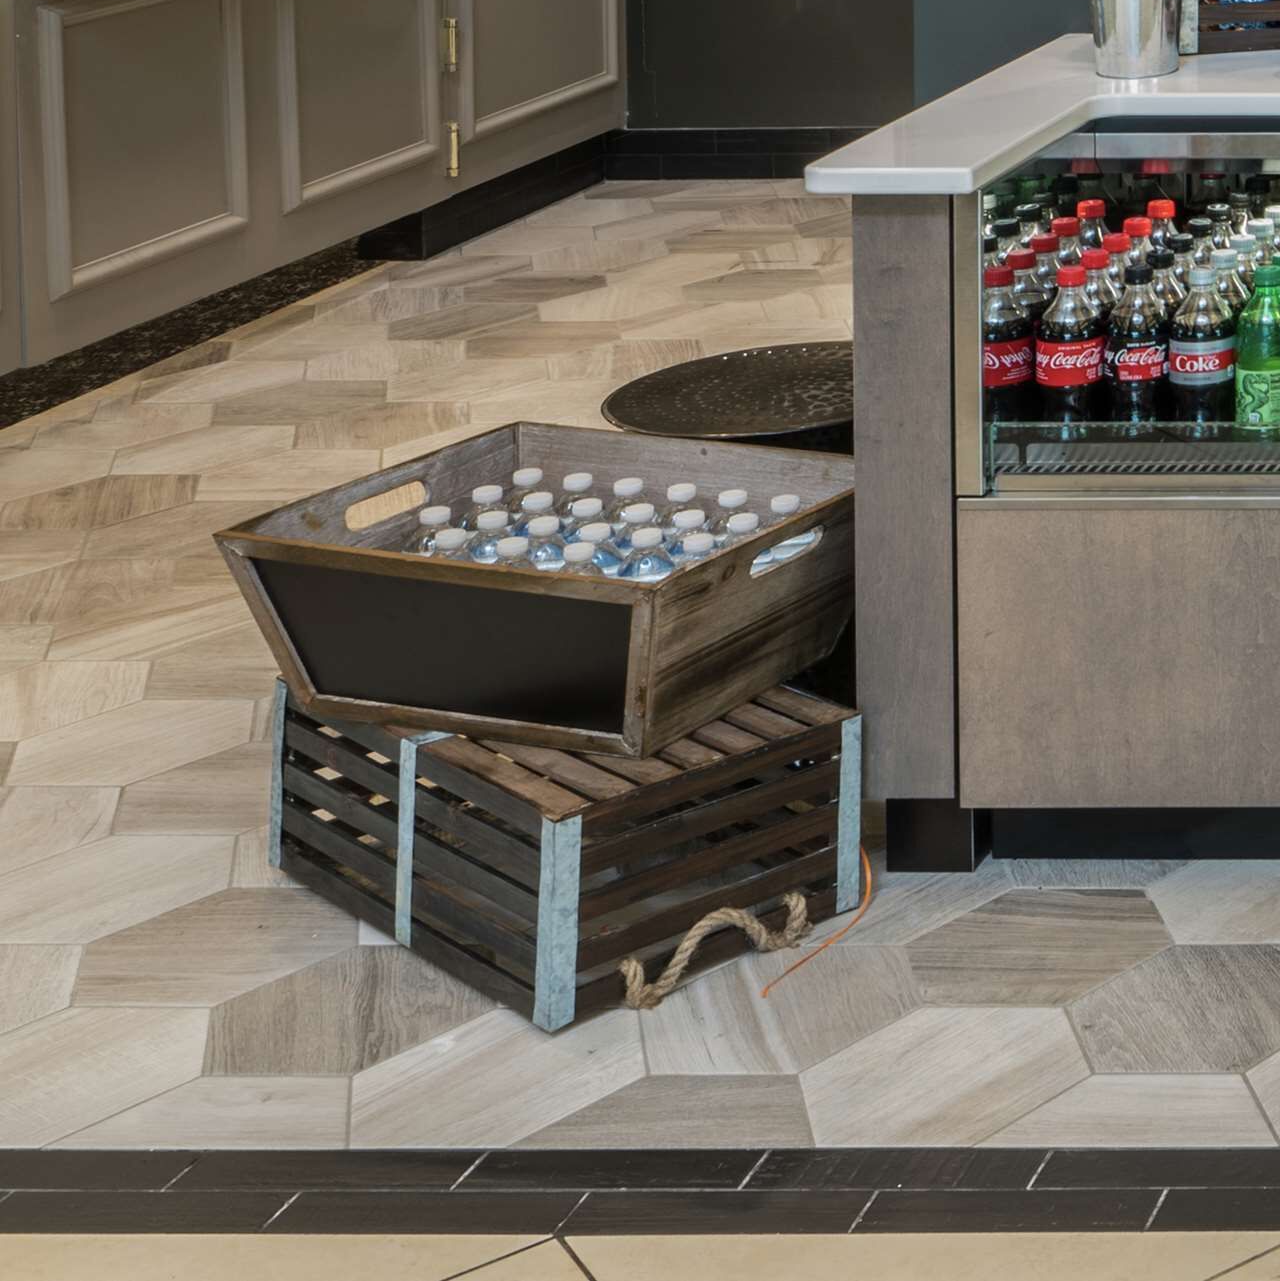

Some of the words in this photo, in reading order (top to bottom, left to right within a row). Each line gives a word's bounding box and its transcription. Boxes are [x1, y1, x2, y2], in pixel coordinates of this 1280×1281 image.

[1050, 347, 1102, 368] Coca-Cola
[1115, 344, 1166, 366] Coca-Cola
[1176, 356, 1220, 372] Coke
